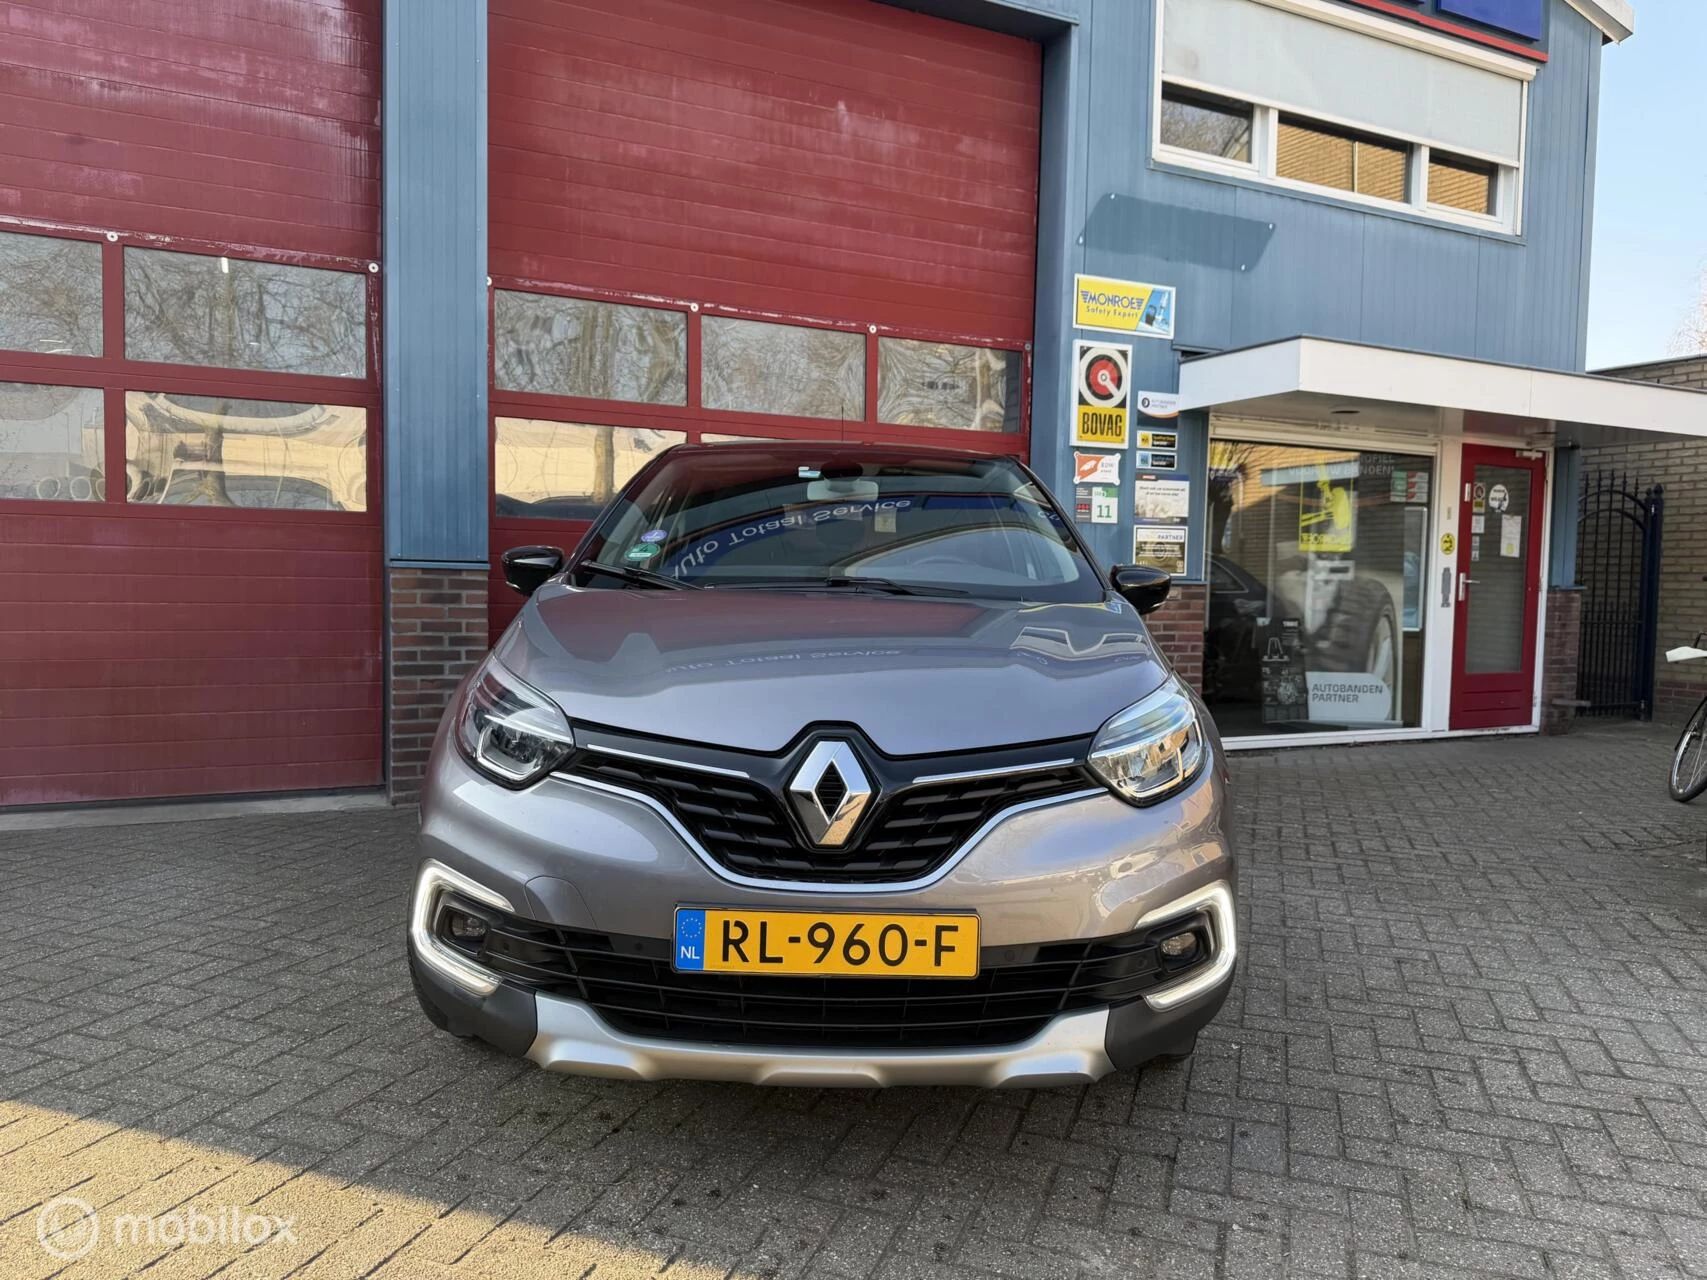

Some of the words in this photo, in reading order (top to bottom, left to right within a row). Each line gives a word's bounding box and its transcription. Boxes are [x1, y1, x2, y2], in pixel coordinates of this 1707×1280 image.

[1087, 292, 1137, 309] MONROE
[1086, 305, 1111, 317] Safety
[1113, 308, 1138, 319] Expert
[1081, 412, 1122, 437] BOVAG
[1096, 504, 1112, 518] 11
[1311, 683, 1383, 694] AUTOBANDEN
[1311, 693, 1359, 703] PARTNER
[721, 919, 959, 966] RL-960-F
[680, 945, 700, 960] NL
